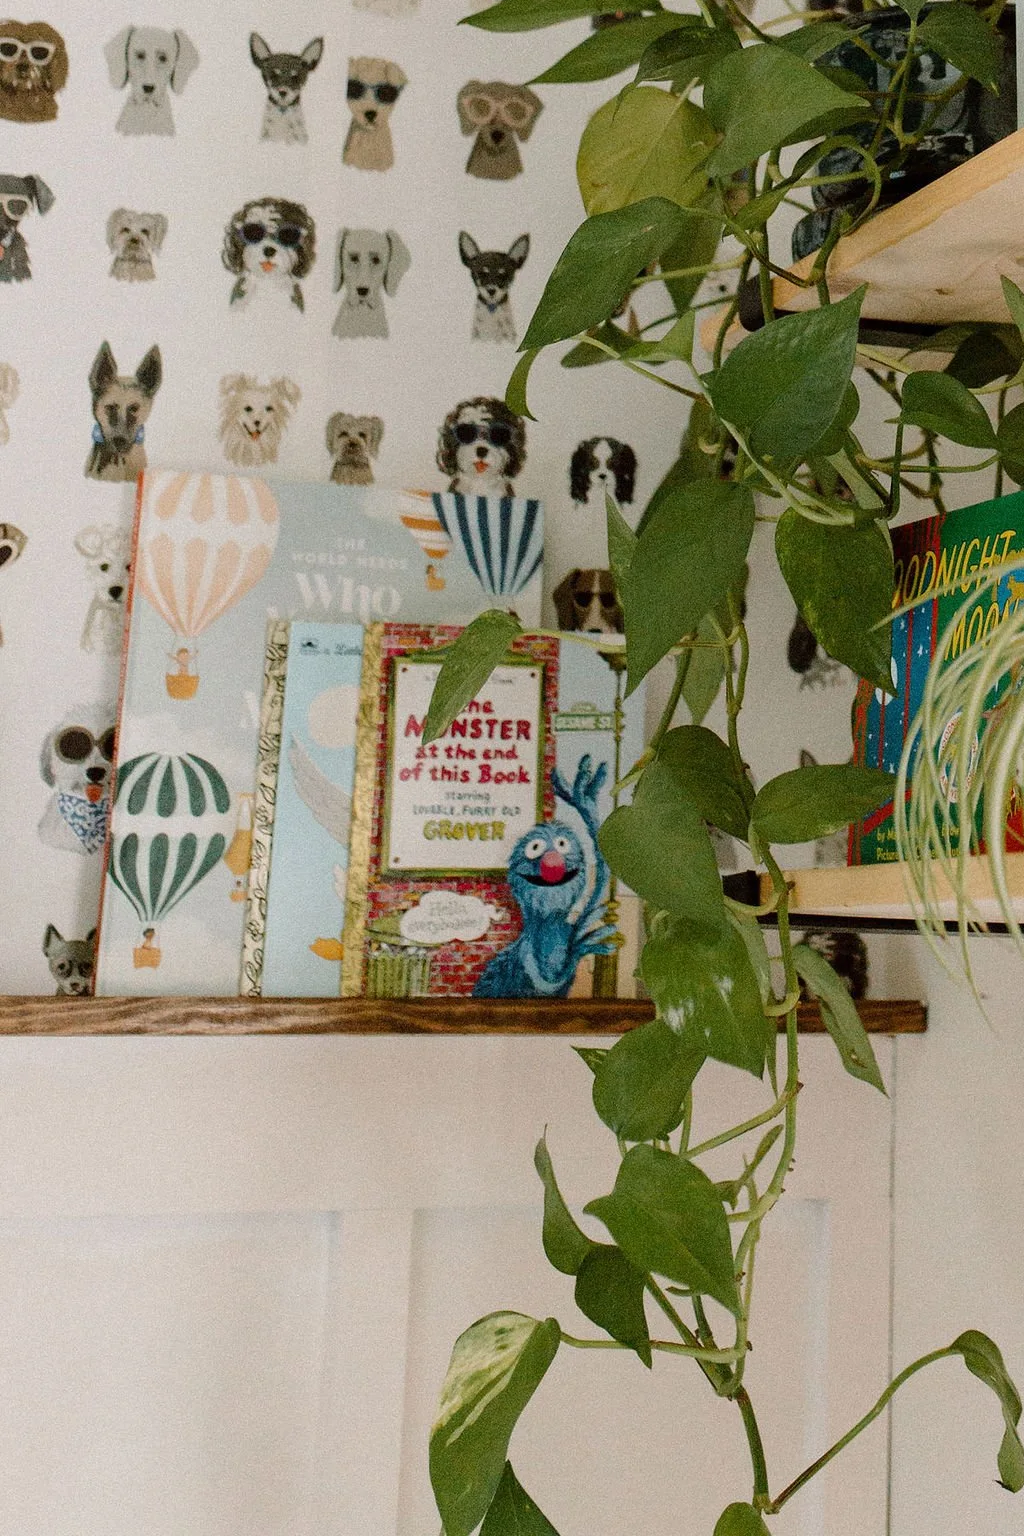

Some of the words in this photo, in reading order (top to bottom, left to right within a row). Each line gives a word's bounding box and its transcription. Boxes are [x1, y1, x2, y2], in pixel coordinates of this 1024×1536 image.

[404, 714, 532, 741] MNSTER
[415, 744, 438, 760] at
[444, 743, 477, 760] the
[482, 744, 519, 760] end
[399, 762, 424, 782] of
[429, 765, 470, 784] this
[478, 764, 531, 785] Book
[423, 819, 507, 842] GROVER
